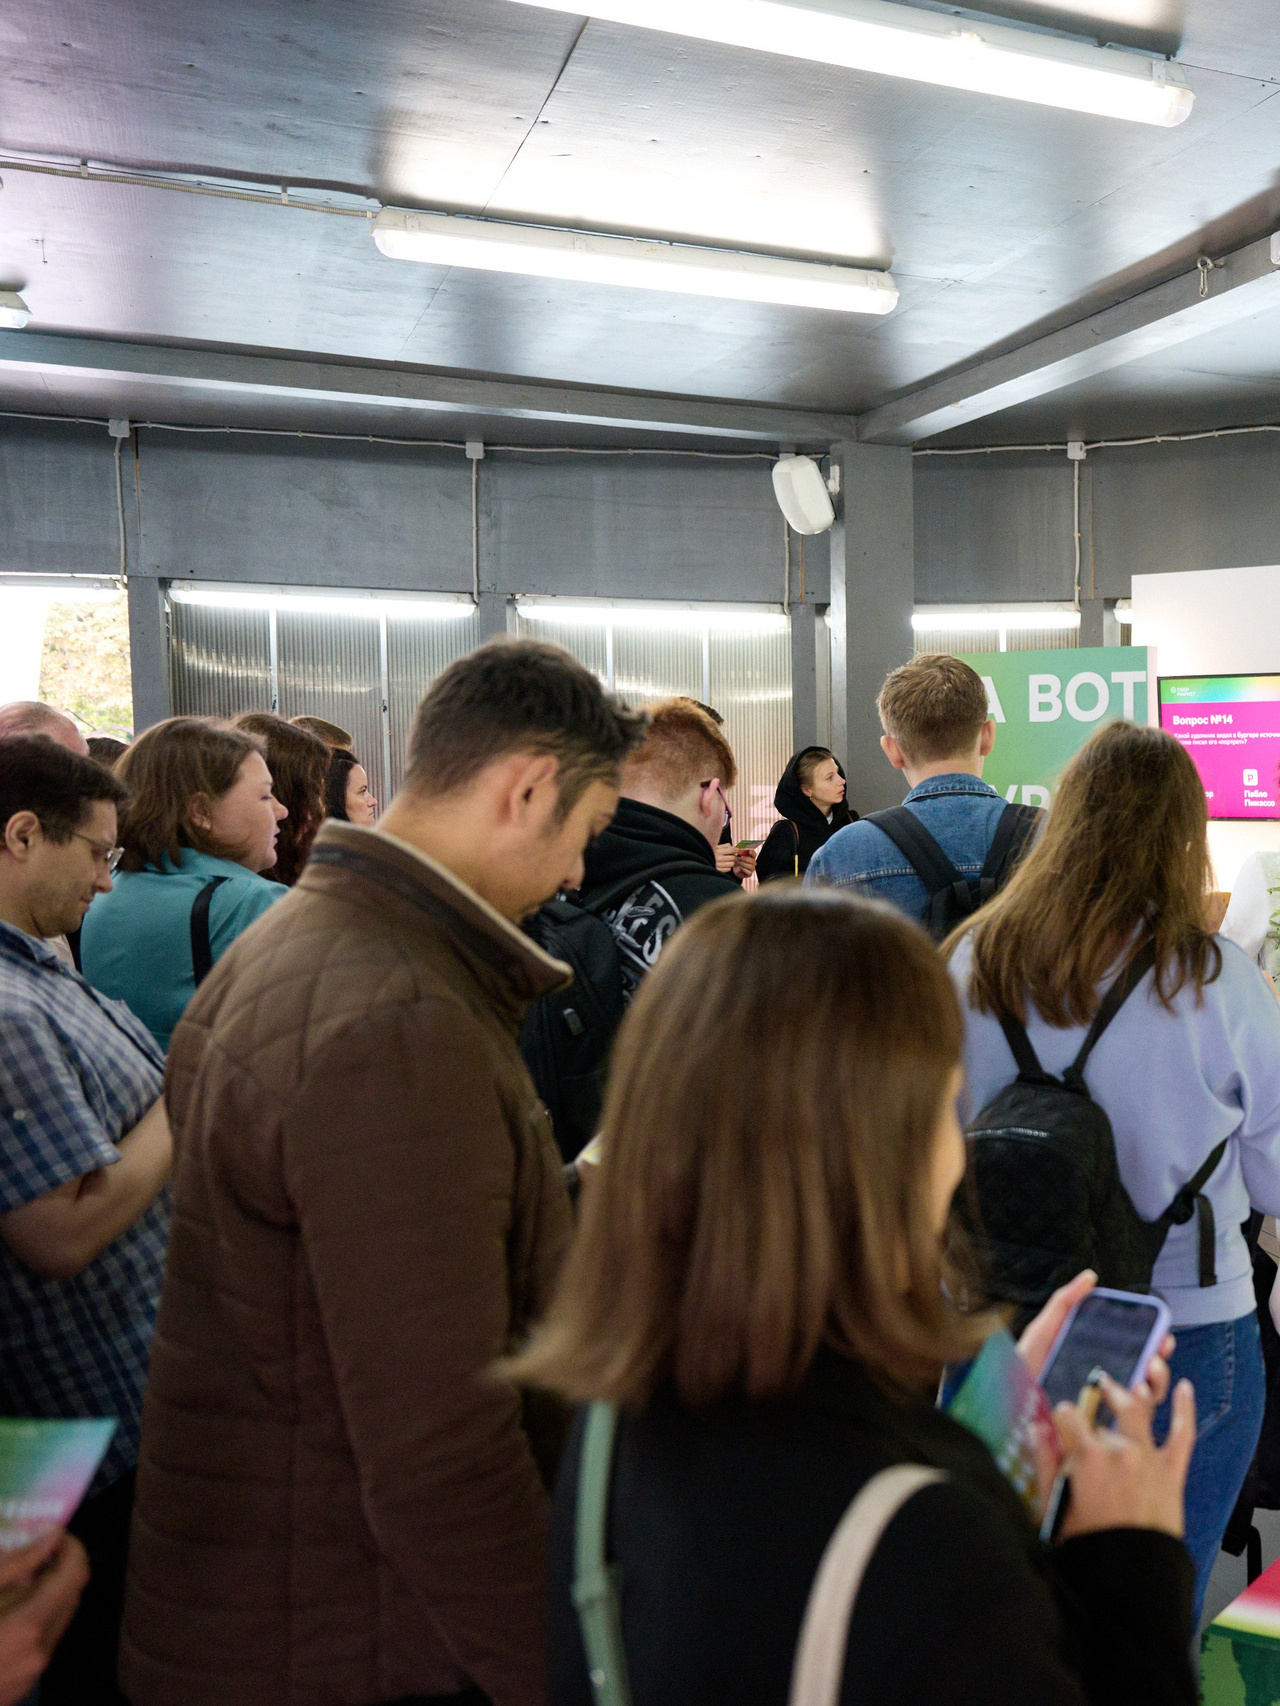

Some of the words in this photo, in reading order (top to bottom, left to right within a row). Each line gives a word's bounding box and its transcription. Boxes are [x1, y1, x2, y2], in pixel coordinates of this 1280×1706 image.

[1029, 671, 1147, 723] ВОТ
[1173, 715, 1209, 727] Вопрос
[1210, 714, 1234, 725] №14
[1237, 731, 1259, 740] бургере
[1243, 789, 1268, 798] Пабло
[1244, 799, 1276, 807] Пикассо
